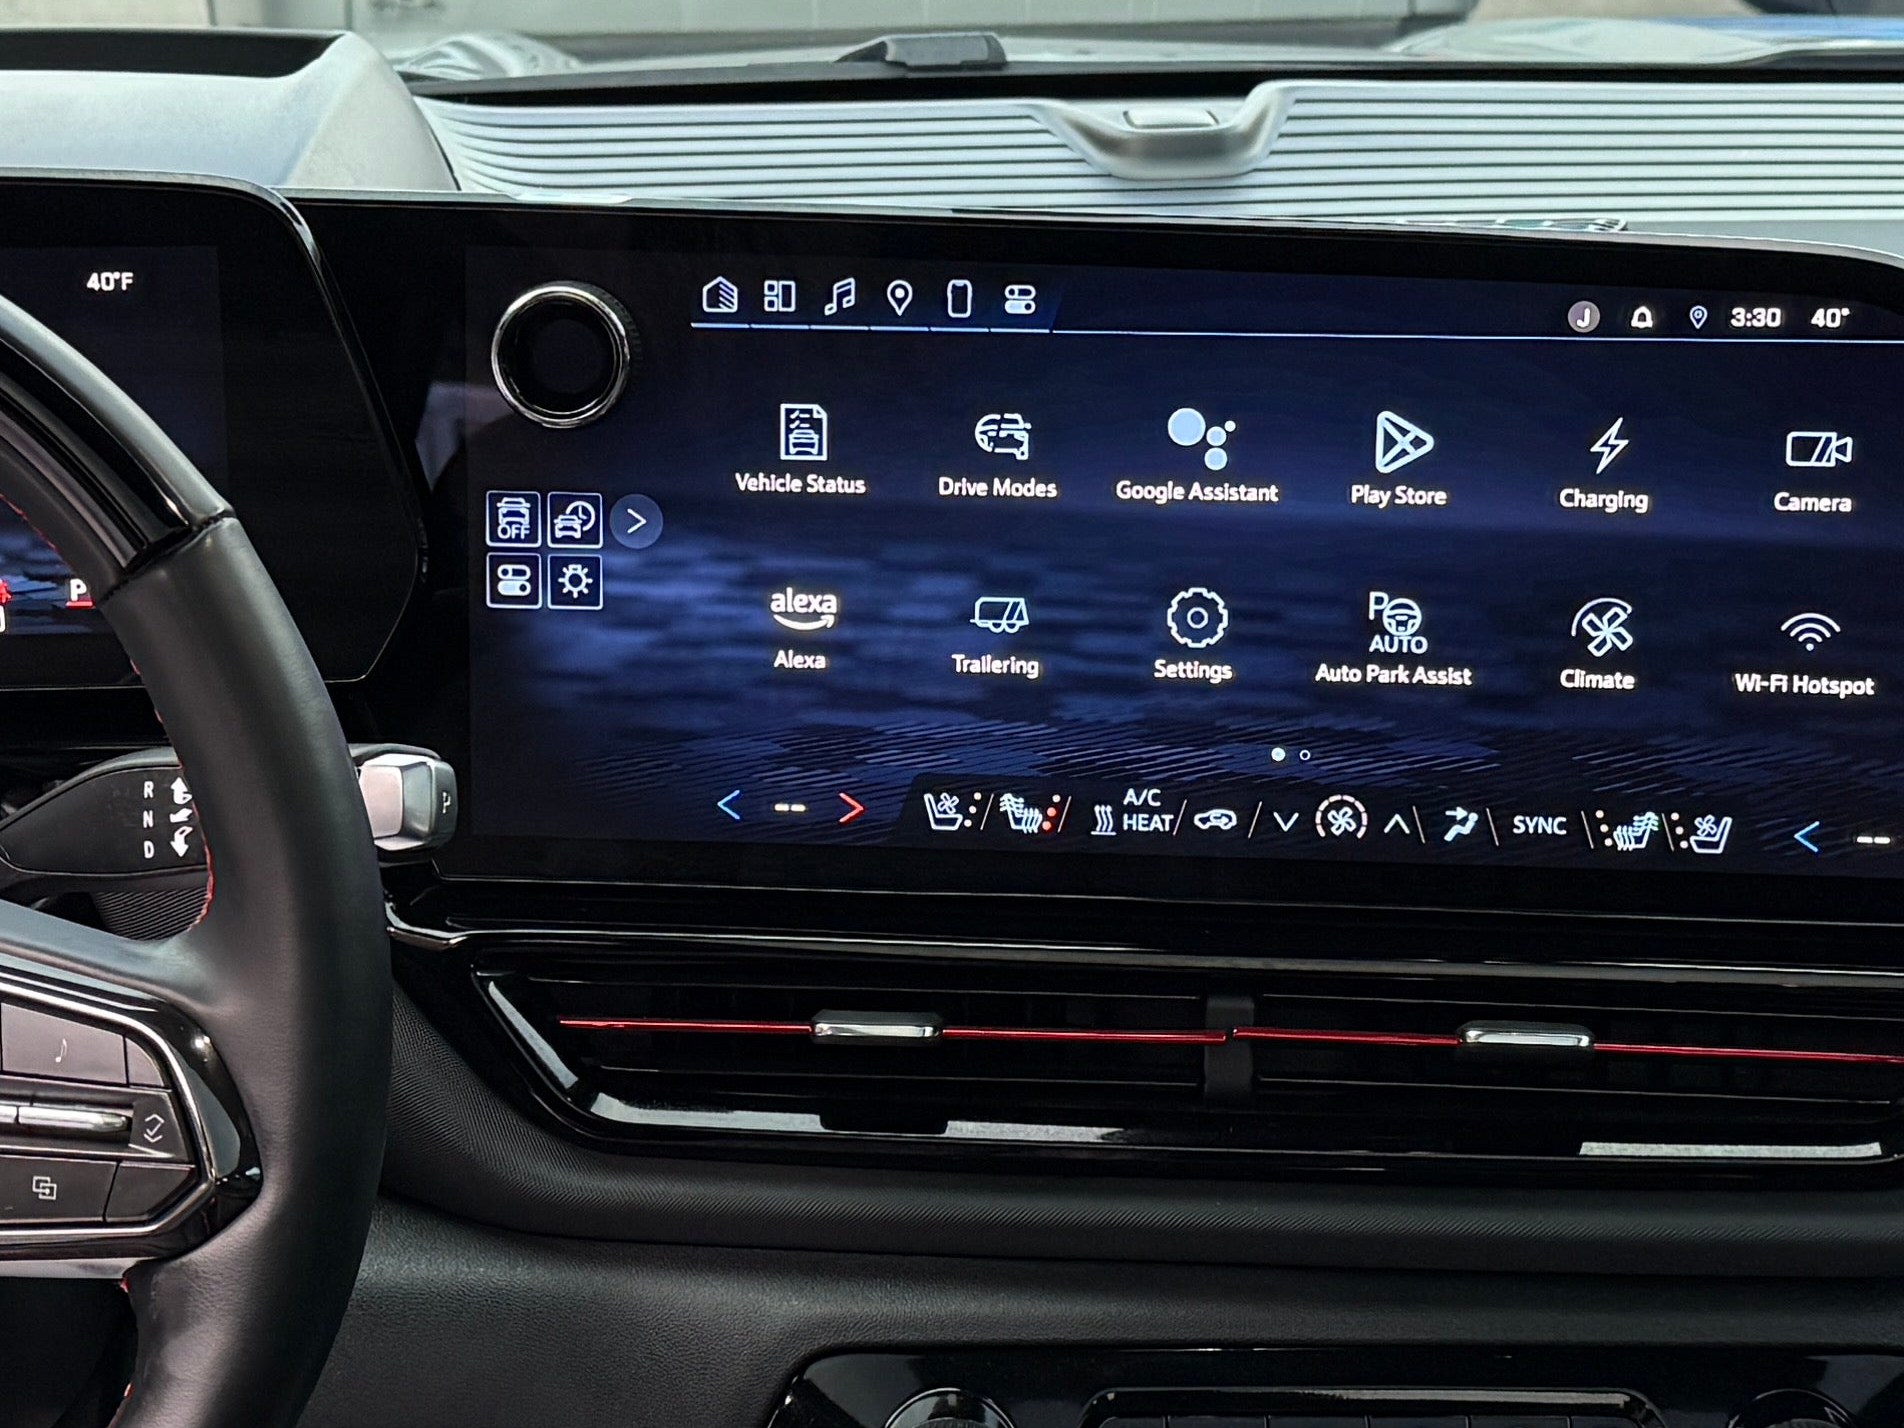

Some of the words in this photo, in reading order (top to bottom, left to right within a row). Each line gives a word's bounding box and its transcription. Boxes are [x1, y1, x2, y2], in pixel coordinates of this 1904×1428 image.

[86, 272, 134, 292] 40°F
[1730, 306, 1782, 328] 3:30
[735, 473, 803, 494] Vehicle
[807, 474, 867, 494] Status
[938, 478, 989, 498] Drive
[993, 479, 1058, 500] Modes
[1116, 481, 1180, 504] Google
[1181, 480, 1279, 505] Assistant
[1350, 484, 1390, 509] Play
[1394, 486, 1448, 508] Store
[1558, 488, 1650, 514] Charging
[1774, 492, 1853, 513] Camera
[497, 523, 530, 540] OFF
[69, 578, 89, 602] P
[769, 588, 838, 615] alexa
[1368, 635, 1428, 654] AUTO
[773, 650, 827, 670] Alexa
[950, 654, 1039, 678] Trailering
[1153, 658, 1233, 681] Settings
[1315, 664, 1364, 683] Auto
[1365, 664, 1410, 685] Park
[1412, 666, 1473, 686] Assist
[1560, 669, 1636, 690] Climate
[1734, 673, 1788, 694] Wi-Fi
[1792, 674, 1875, 698] Hotspot
[142, 780, 155, 799] R
[1123, 788, 1162, 808] A/C
[142, 810, 155, 829] N
[1122, 813, 1175, 833] HEAT
[1512, 814, 1568, 836] SYNC
[143, 840, 156, 859] D
